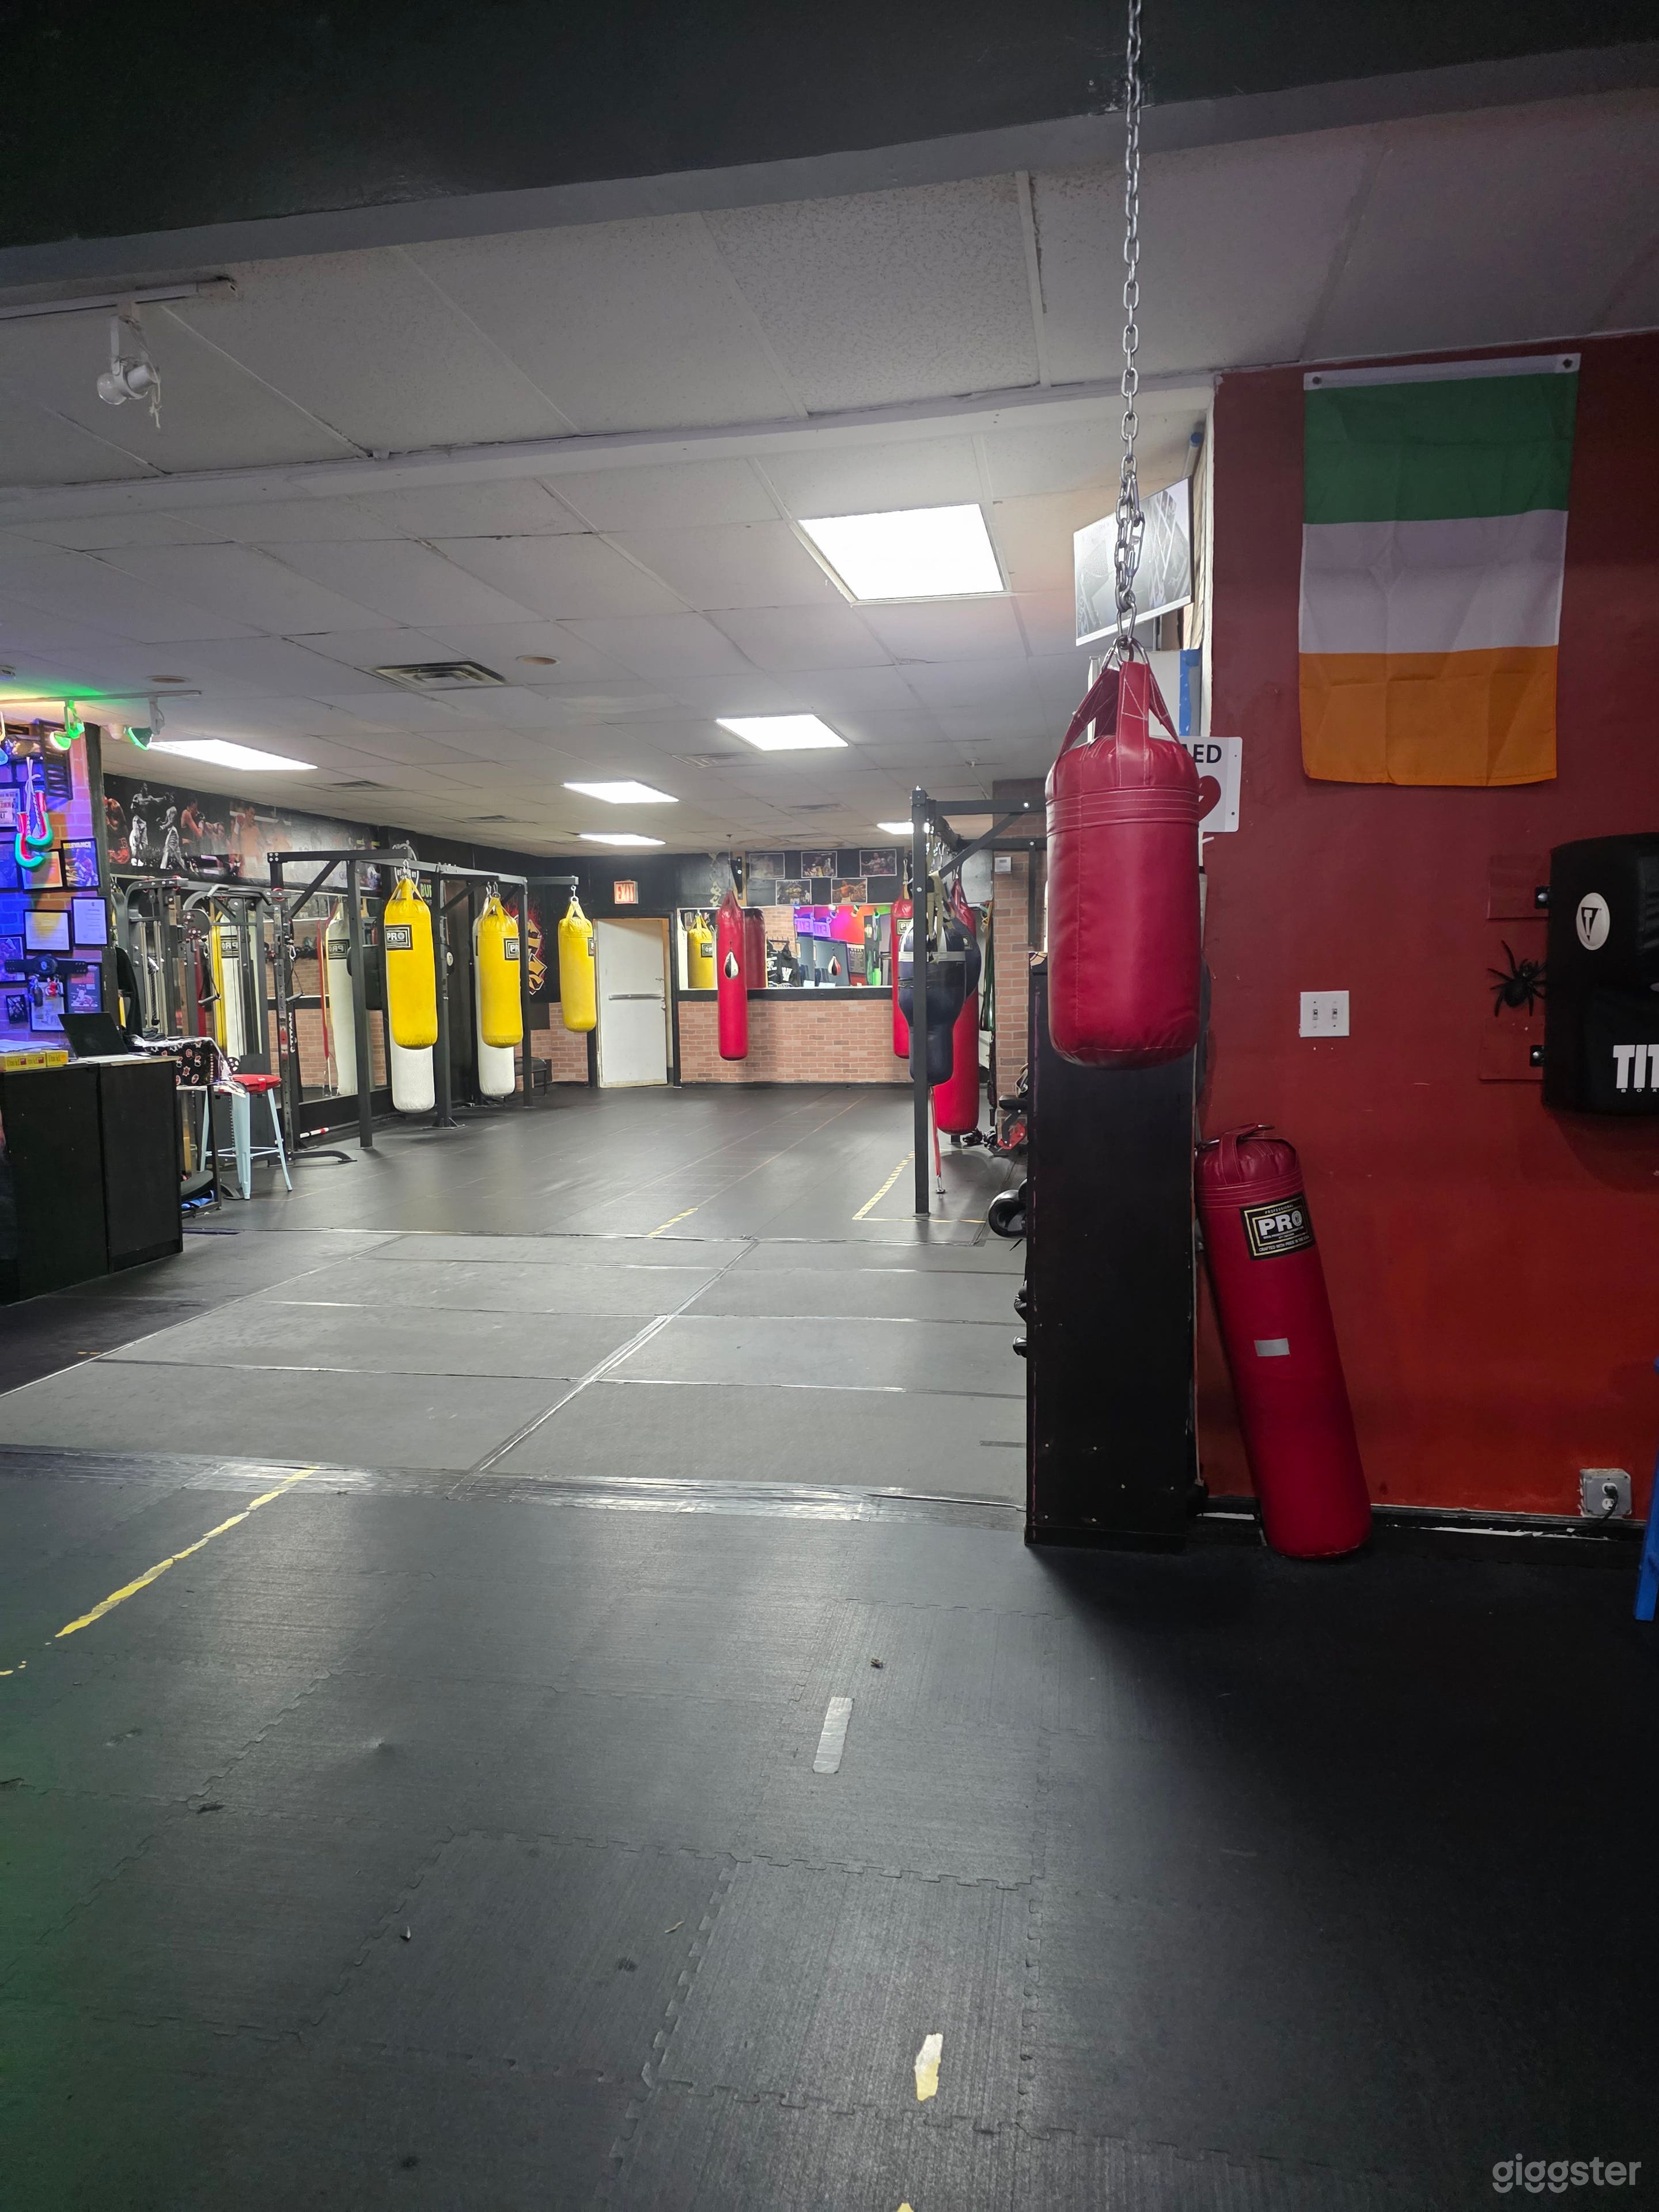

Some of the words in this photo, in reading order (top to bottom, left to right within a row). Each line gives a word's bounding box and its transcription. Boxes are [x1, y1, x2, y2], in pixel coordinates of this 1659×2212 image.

[1181, 744, 1222, 763] ED
[617, 884, 634, 902] EXIT
[387, 933, 405, 941] PRO
[1258, 1210, 1302, 1236] PRO
